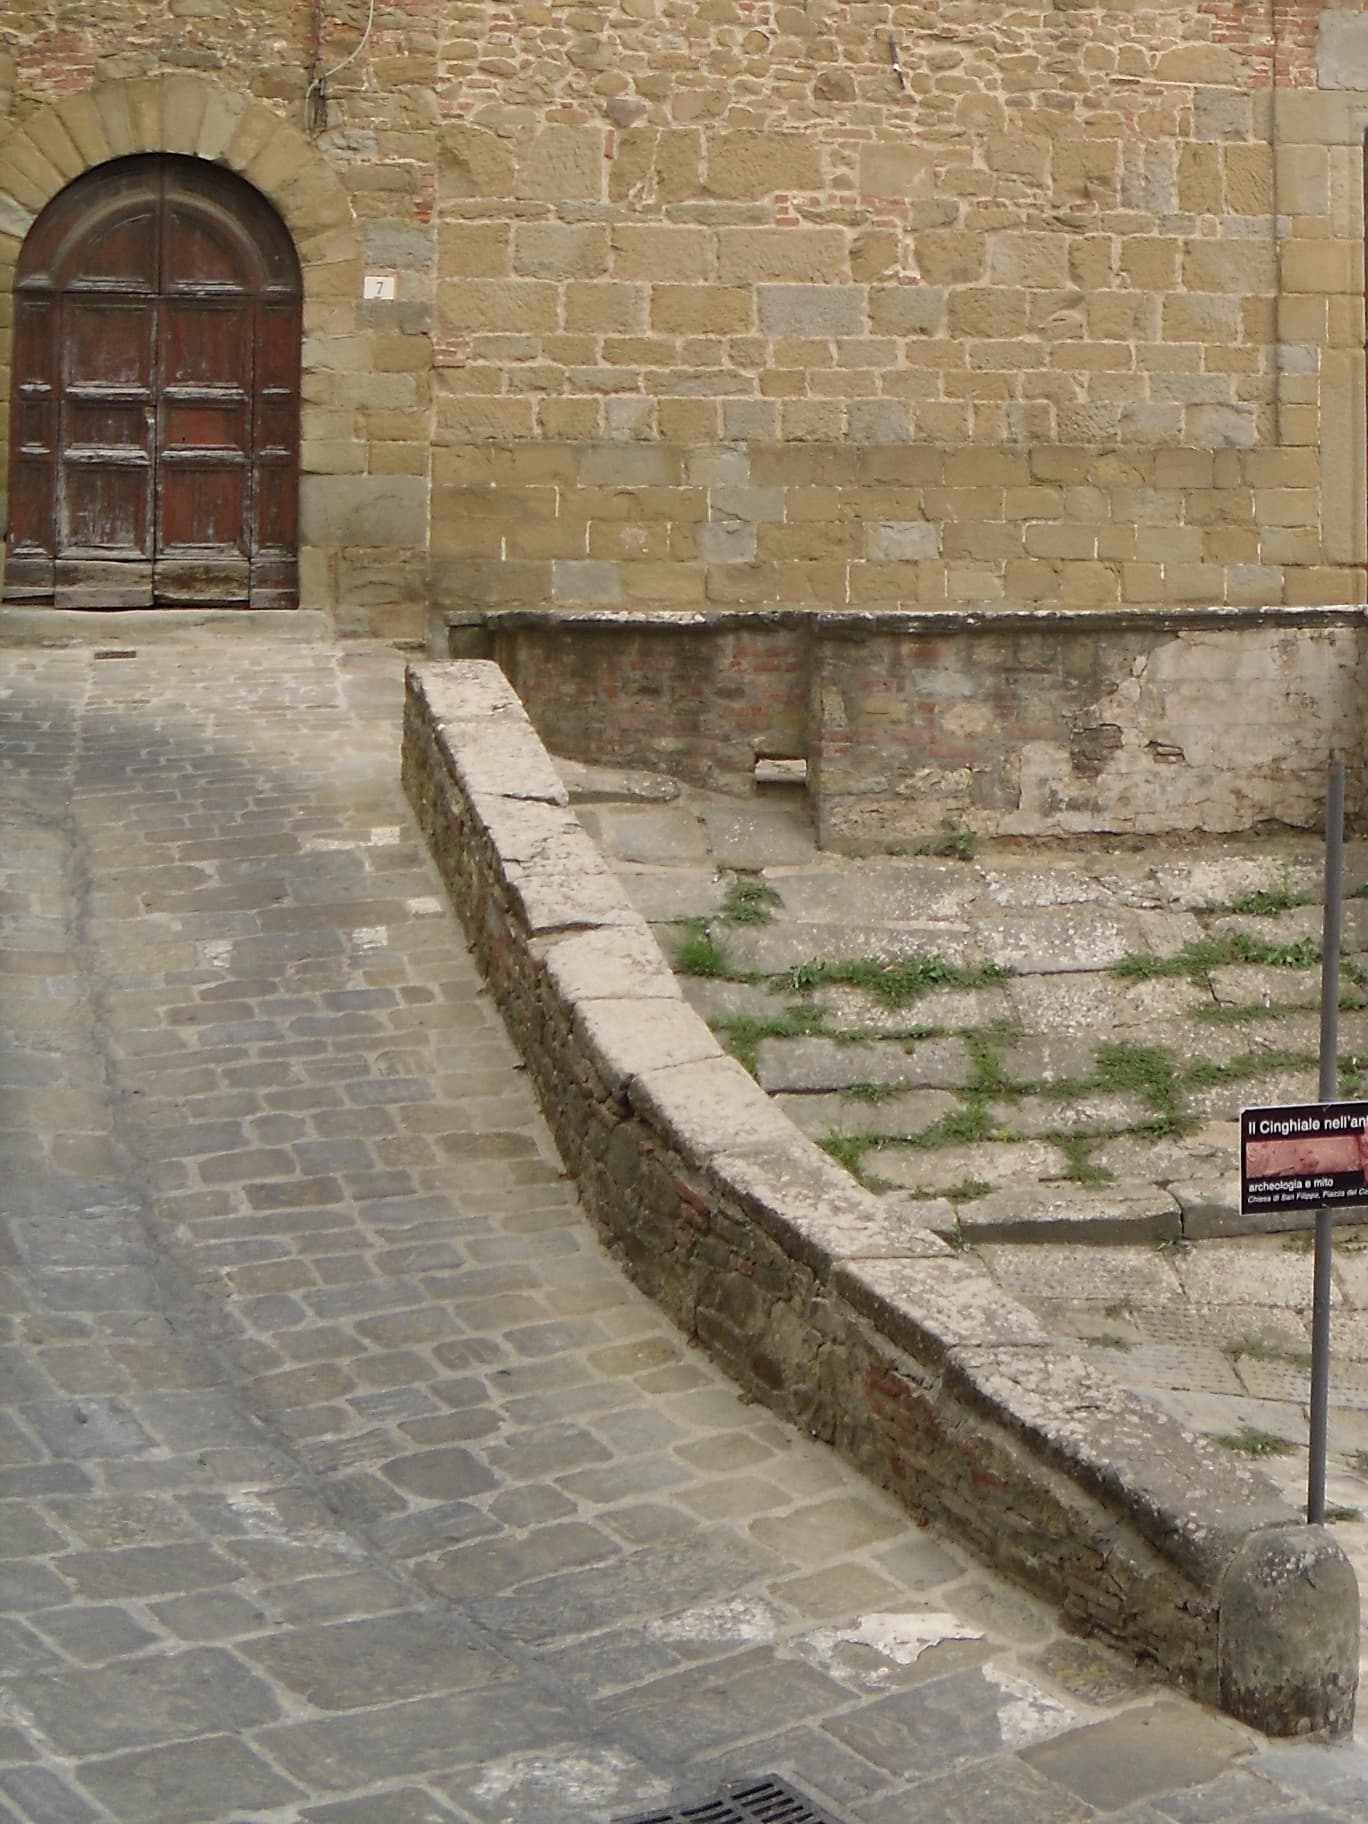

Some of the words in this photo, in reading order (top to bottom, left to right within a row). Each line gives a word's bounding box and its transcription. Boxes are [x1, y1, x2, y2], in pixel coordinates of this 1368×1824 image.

[376, 281, 384, 295] 7
[1248, 1121, 1256, 1135] Il
[1259, 1117, 1321, 1136] Cinghiale
[1248, 1180, 1303, 1193] archeologia
[1304, 1180, 1311, 1189] e
[1313, 1177, 1334, 1188] mito
[1281, 1193, 1295, 1202] San
